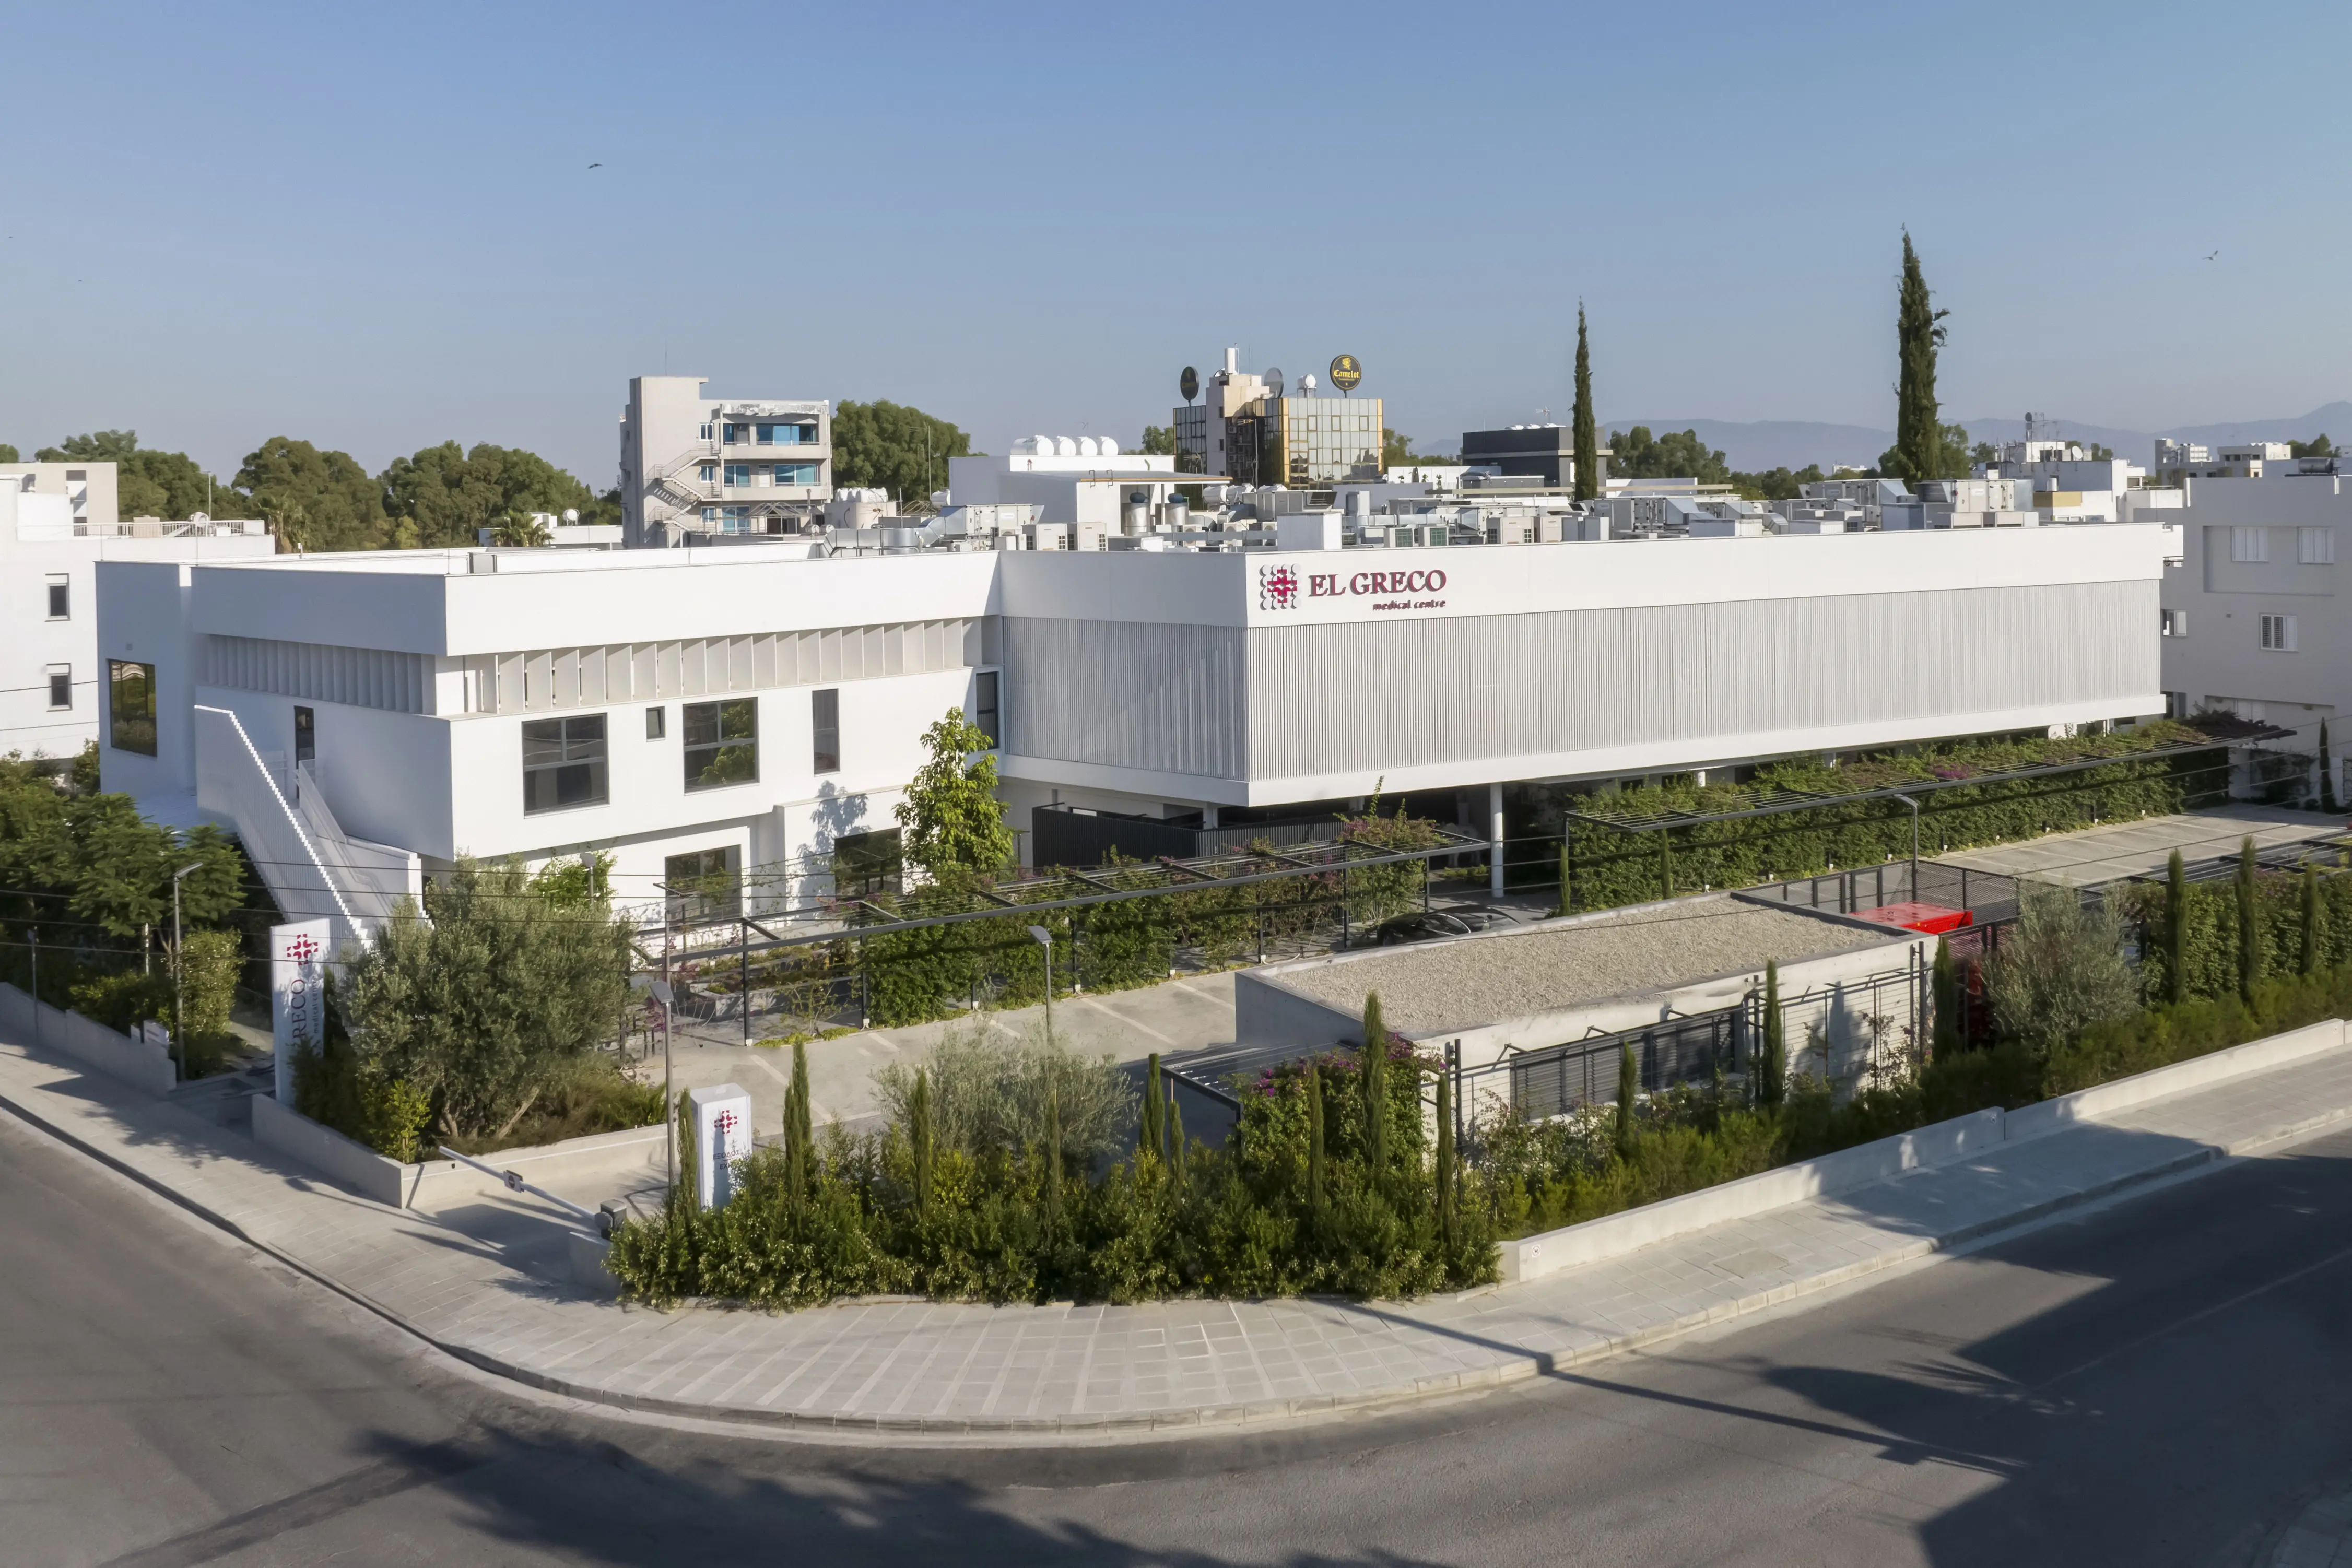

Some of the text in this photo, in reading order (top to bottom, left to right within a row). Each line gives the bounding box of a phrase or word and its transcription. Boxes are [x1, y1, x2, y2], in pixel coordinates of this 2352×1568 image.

[1334, 369, 1359, 378] Camelot
[1308, 570, 1447, 597] EL GRECO
[1372, 599, 1446, 611] medical centre
[291, 979, 307, 1038] RECO
